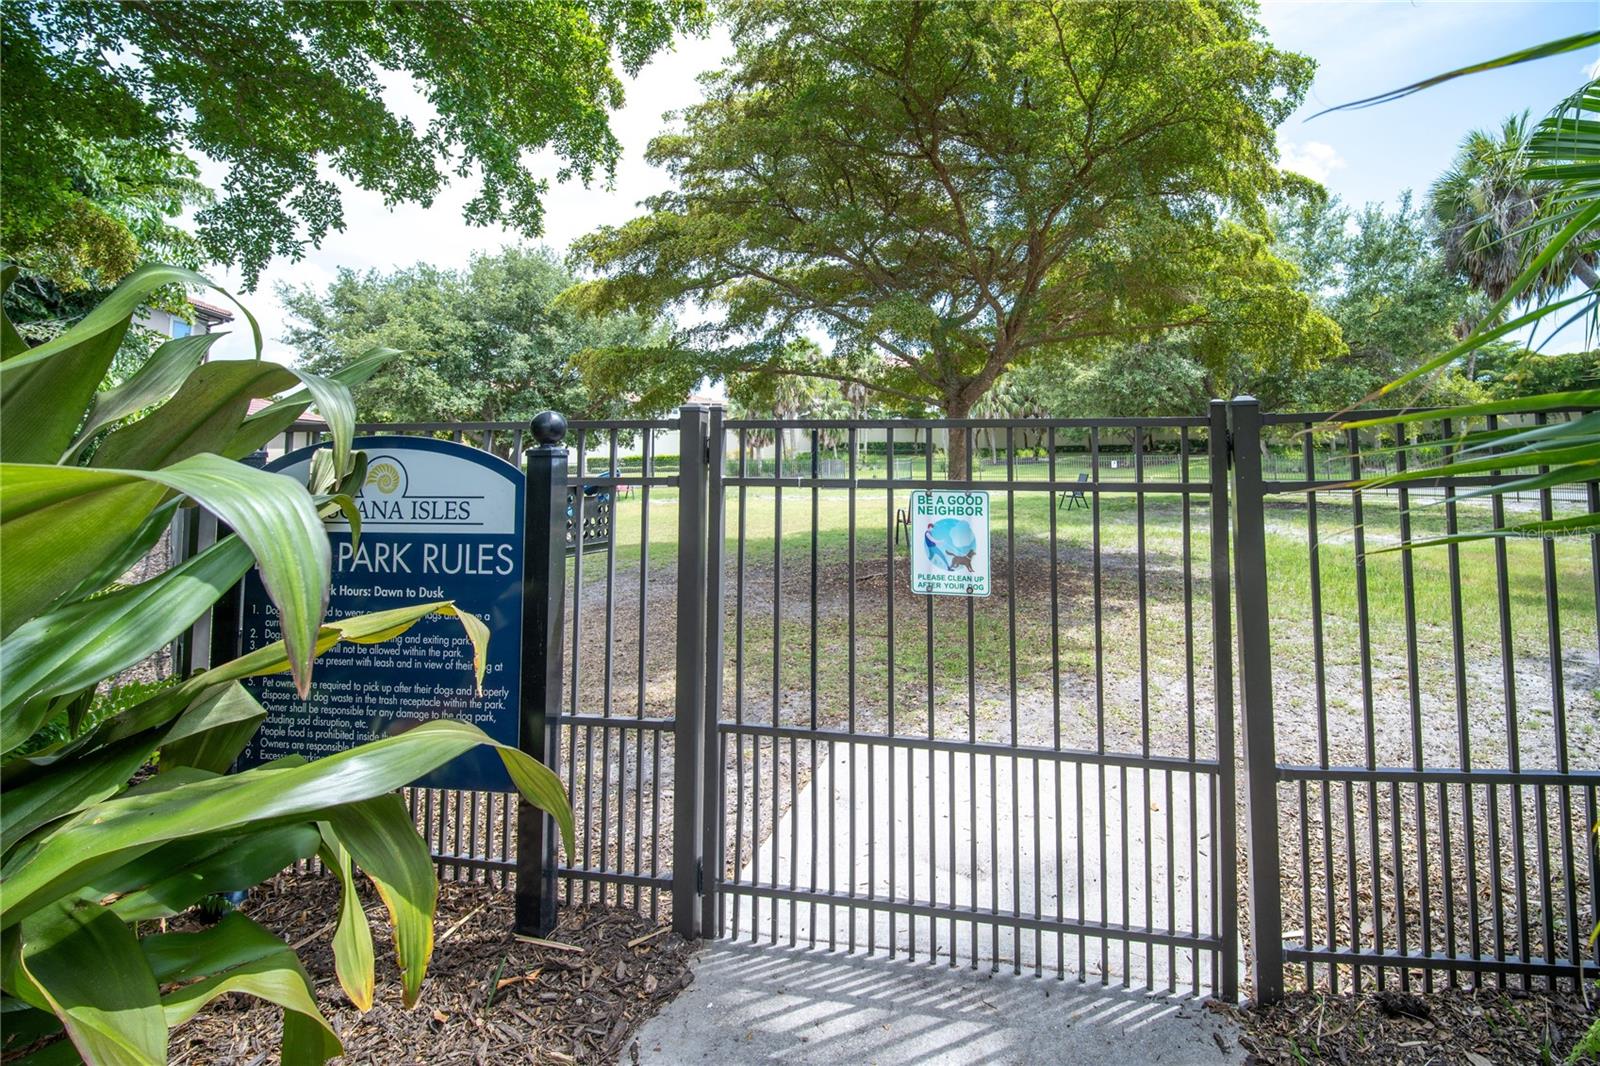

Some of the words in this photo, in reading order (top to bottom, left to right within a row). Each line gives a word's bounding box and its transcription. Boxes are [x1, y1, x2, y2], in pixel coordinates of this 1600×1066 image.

[918, 495, 932, 505] BE
[936, 496, 944, 505] A
[947, 496, 983, 506] GOOD
[411, 501, 471, 520] ISLES
[918, 506, 983, 516] NEIGHBOR
[338, 543, 412, 574] PARK
[423, 543, 514, 576] RULES
[340, 585, 371, 597] Hours:
[374, 586, 403, 598] Dawn
[406, 588, 416, 598] to
[418, 586, 444, 599] Dusk
[968, 583, 984, 591] DOG
[252, 604, 259, 615] 1.
[266, 604, 281, 618] Dog
[335, 608, 343, 617] to
[250, 628, 258, 638] 2.
[404, 634, 420, 644] and
[422, 635, 449, 647] exiting
[343, 646, 355, 654] not
[357, 644, 367, 654] be
[369, 644, 400, 655] allowed
[402, 646, 426, 656] within
[428, 647, 441, 656] the
[443, 648, 464, 658] park.
[326, 656, 354, 667] present
[355, 656, 372, 667] with
[374, 657, 394, 668] leash
[396, 658, 412, 668] and
[414, 659, 422, 668] in
[424, 659, 444, 670] view
[445, 659, 454, 670] of
[455, 660, 473, 670] their
[494, 662, 503, 671] at
[262, 678, 274, 687] Pet
[275, 680, 296, 688] owne
[319, 680, 352, 692] required
[354, 682, 361, 691] to
[363, 680, 379, 694] pick
[381, 684, 392, 694] up
[394, 682, 412, 693] after
[414, 683, 432, 694] their
[434, 684, 454, 697] dogs
[456, 685, 472, 695] and
[474, 686, 509, 698] poperly
[262, 689, 290, 702] dispose
[312, 691, 329, 704] dog
[330, 693, 353, 703] waste
[355, 692, 362, 703] in
[364, 692, 377, 704] the
[378, 694, 398, 705] trash
[400, 695, 440, 709] receptacle
[442, 697, 467, 708] within
[469, 697, 482, 708] the
[484, 699, 506, 711] park.
[289, 703, 306, 713] shall
[308, 702, 319, 714] be
[320, 704, 364, 717] responsible
[366, 705, 377, 716] for
[379, 710, 394, 720] any
[396, 708, 429, 721] damage
[431, 710, 440, 719] to
[441, 710, 454, 719] the
[456, 710, 472, 722] dog
[474, 711, 497, 724] park,
[296, 716, 310, 725] sod
[312, 716, 352, 730] disruption,
[354, 719, 368, 729] etc.
[260, 727, 286, 738] People
[288, 726, 306, 737] food
[307, 728, 314, 738] is
[315, 729, 354, 740] prohibited
[356, 731, 380, 742] inside
[260, 737, 290, 749] Owners
[291, 741, 305, 749] are
[306, 740, 349, 753] responsible
[245, 748, 253, 759] 9.
